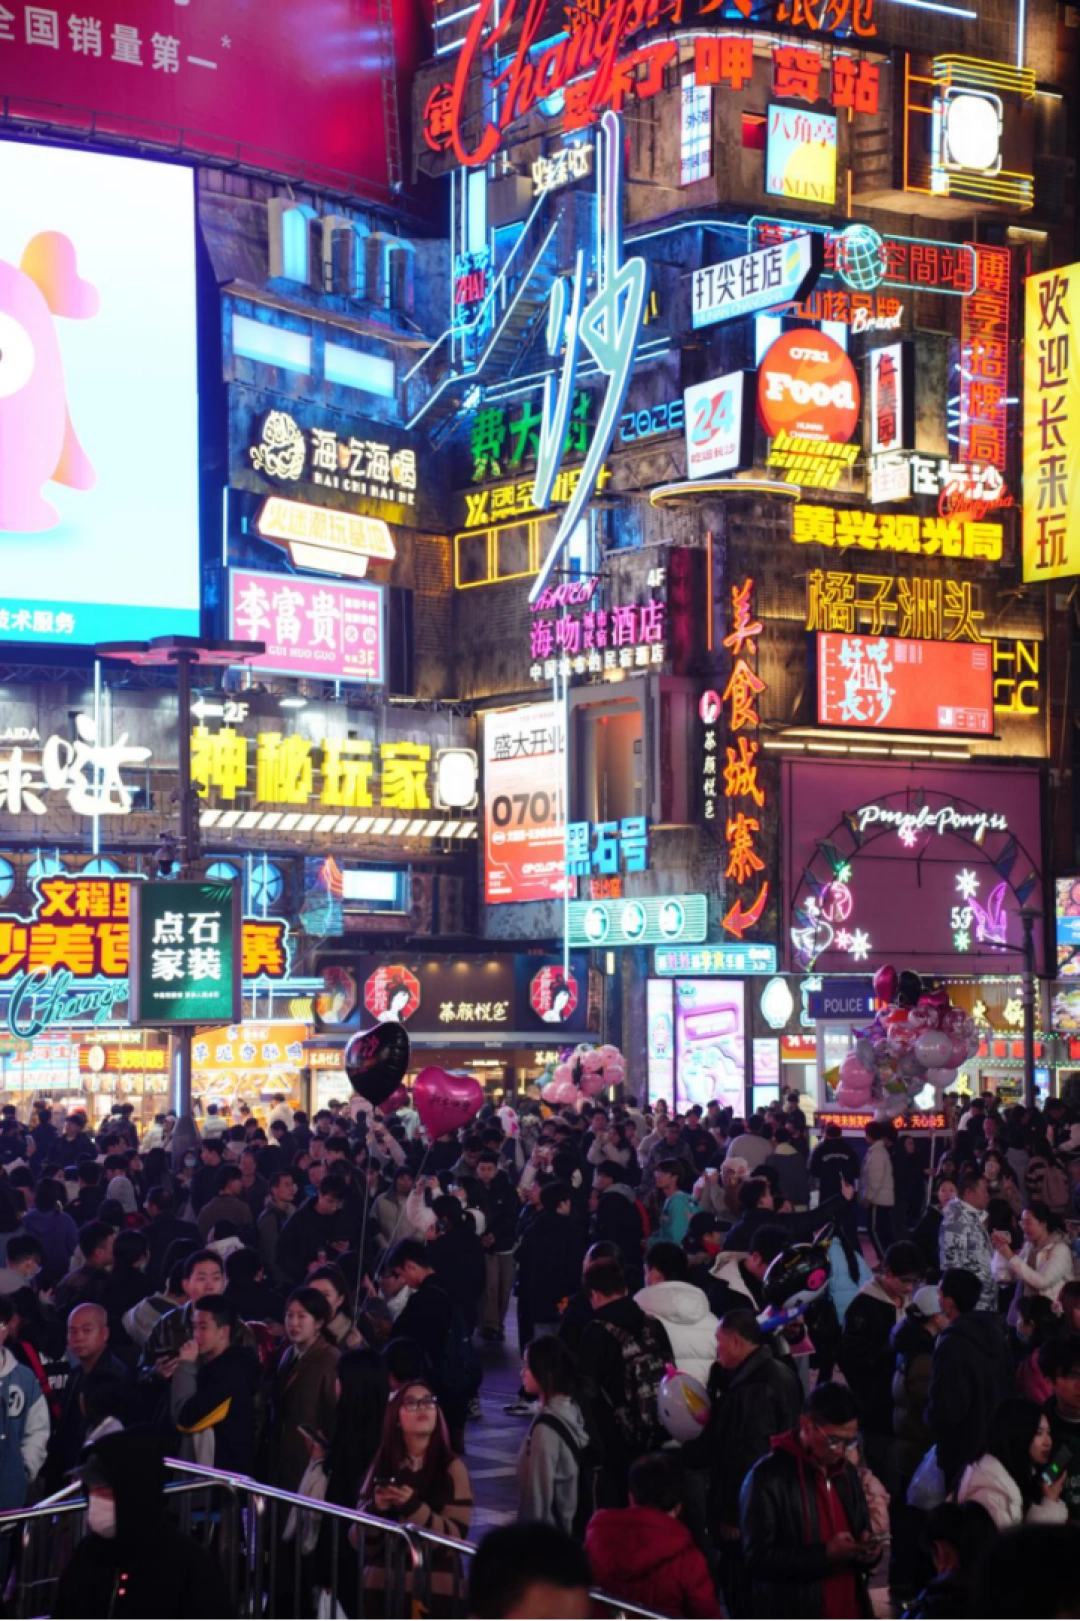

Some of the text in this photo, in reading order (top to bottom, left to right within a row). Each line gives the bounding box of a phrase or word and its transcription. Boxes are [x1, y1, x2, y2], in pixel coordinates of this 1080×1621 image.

[771, 111, 836, 148] 八角亭
[695, 249, 783, 310] 打尖住店
[765, 371, 856, 411] Food
[1035, 273, 1070, 570] 欢迎长来玩
[313, 472, 340, 489] HAI
[342, 478, 367, 495] CHI
[369, 485, 396, 501] HAI
[793, 504, 1003, 562] 黄兴观光局
[233, 581, 343, 650] 李富贵
[806, 568, 985, 643] 橘子洲头
[223, 701, 250, 723] 2F
[722, 577, 768, 884] 美食城寨
[190, 726, 431, 810] 神秘玩家
[152, 911, 222, 945] 点石
[152, 947, 222, 981] 家装
[439, 1000, 507, 1023] 茶颜悦色
[823, 998, 864, 1013] POLICE
